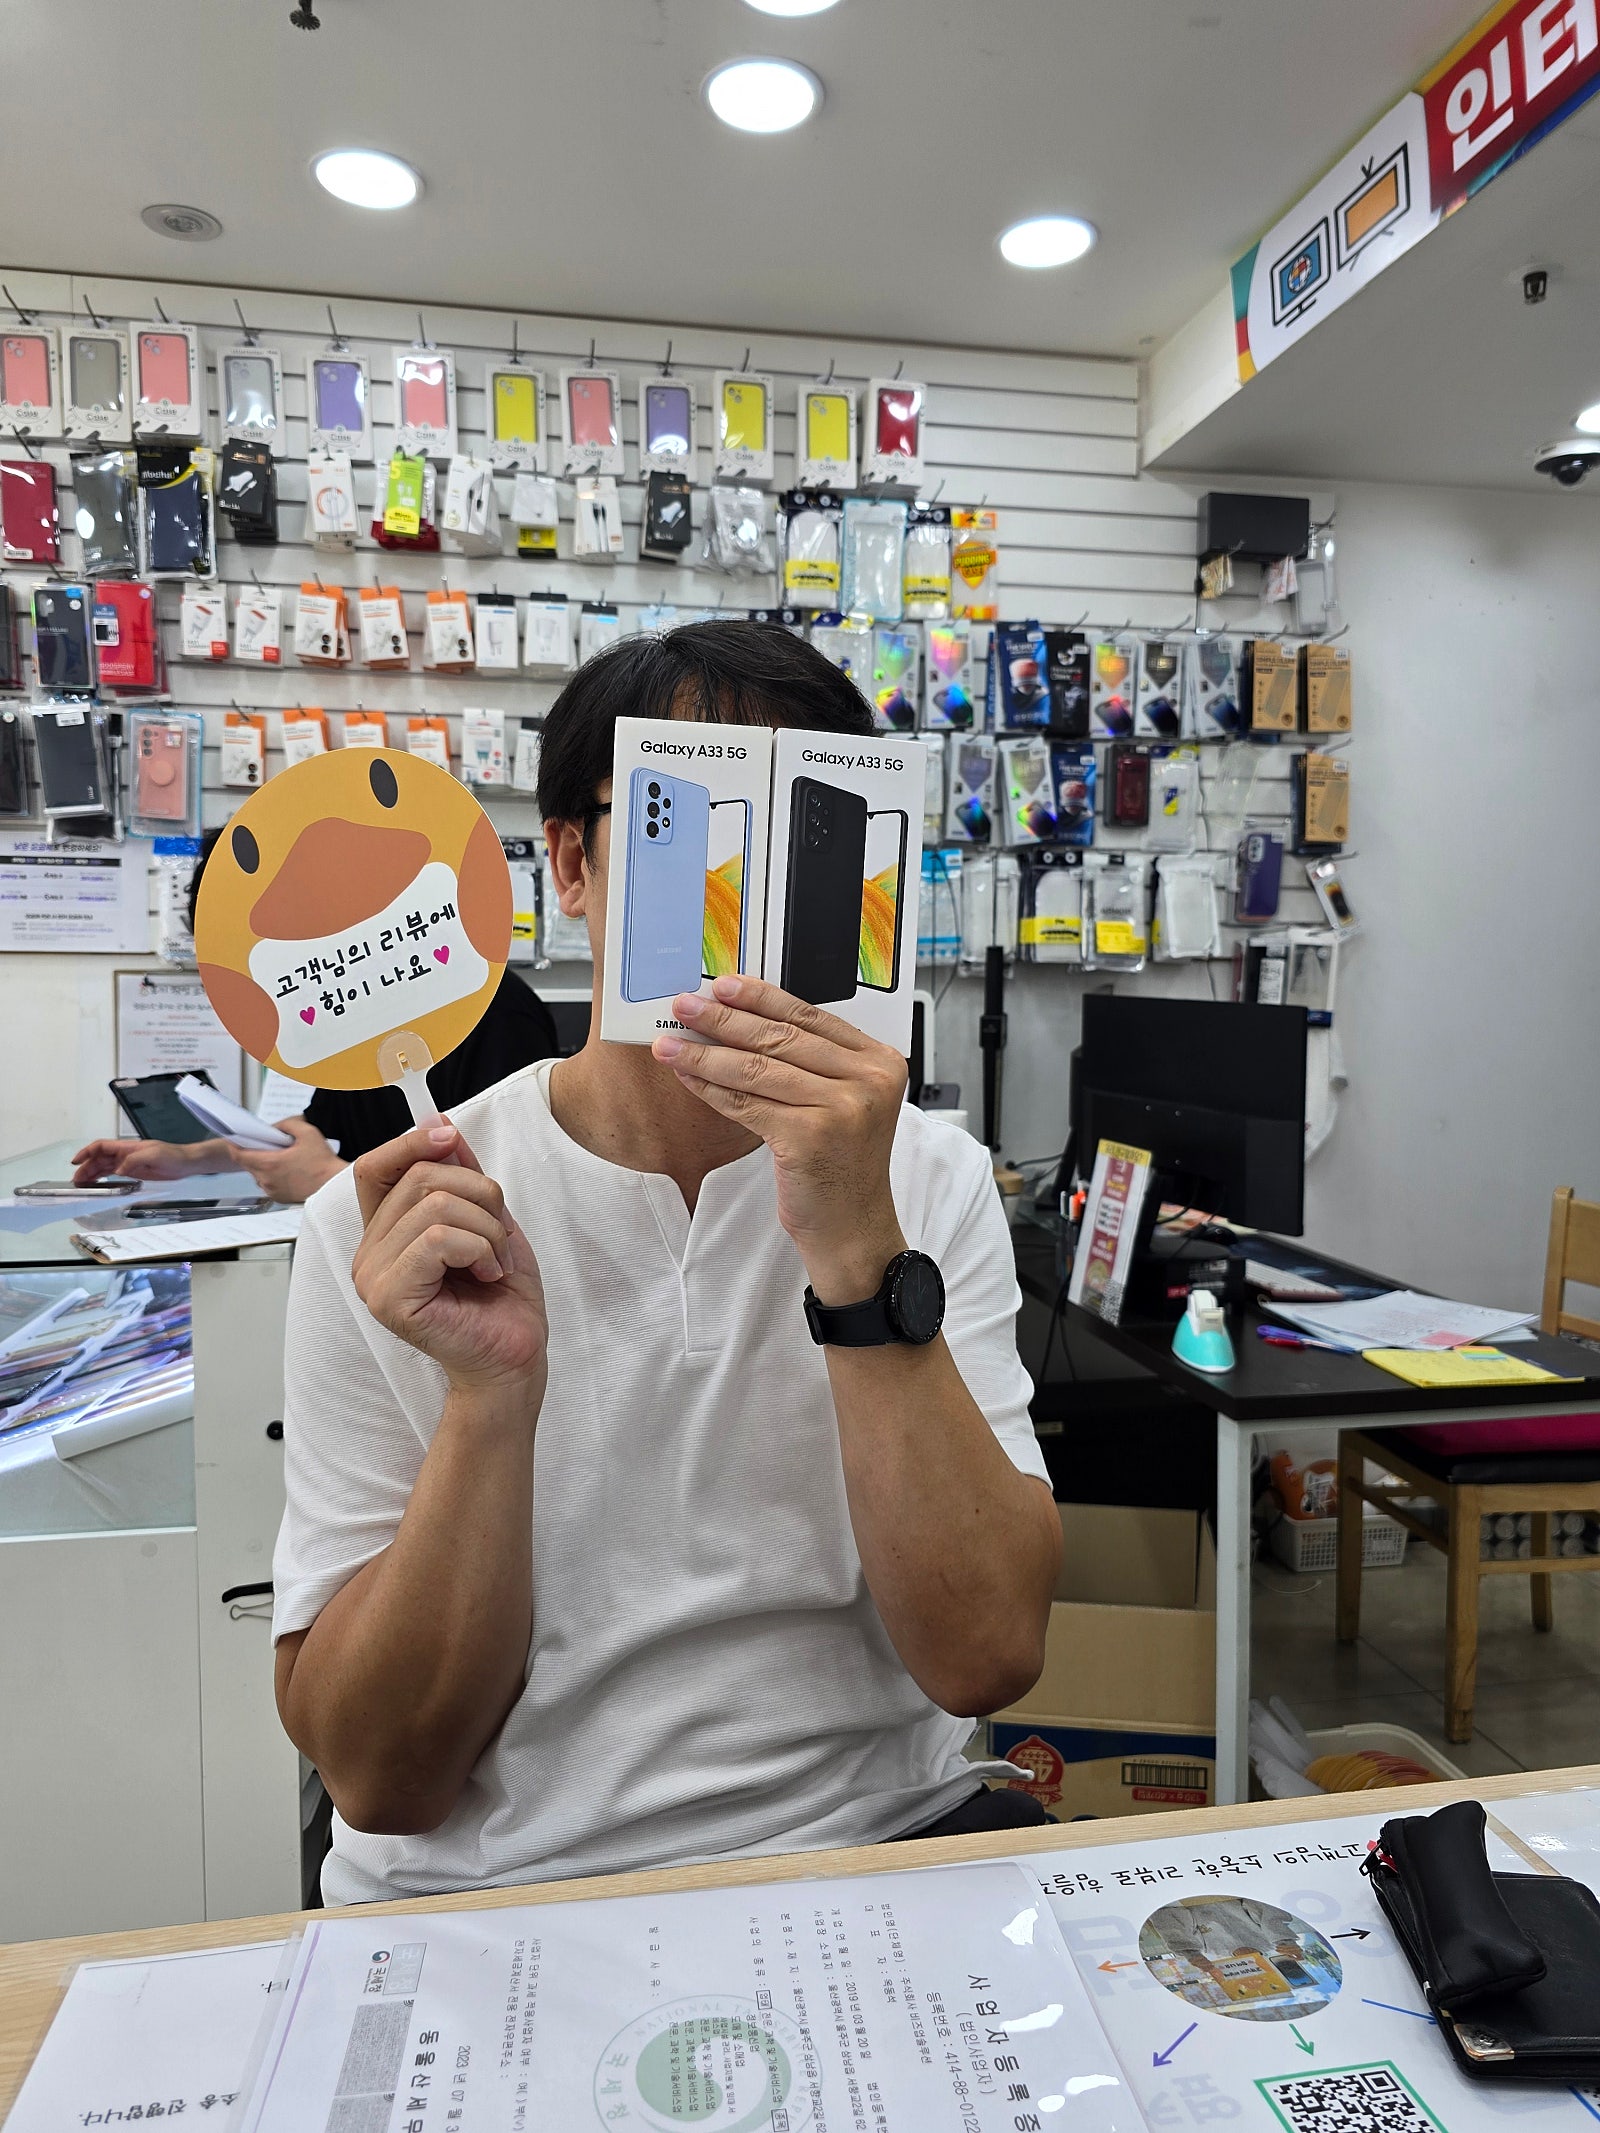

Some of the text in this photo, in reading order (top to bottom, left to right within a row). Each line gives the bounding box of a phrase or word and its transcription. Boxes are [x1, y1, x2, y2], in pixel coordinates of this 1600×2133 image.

[1446, 0, 1600, 172] 인터
[640, 741, 747, 760] Galaxy A33 5G
[802, 750, 903, 771] Galaxy A33 5G
[275, 903, 455, 999] 고객님의 리뷰에
[319, 954, 432, 1018] 힘이 나요
[1273, 1843, 1365, 1864] 고객님의
[1111, 1866, 1183, 1886] 리뷰로
[1192, 1854, 1262, 1880] 소중한
[814, 1910, 827, 1935] 사업장
[531, 1938, 542, 1961] 사업자
[820, 1943, 833, 1970] 소재지
[510, 1940, 524, 1992] 전자세금계산서
[529, 1964, 539, 1979] 단위
[368, 1967, 387, 1993] 국세청
[526, 1983, 537, 1998] 과세
[845, 1982, 858, 2001] 2019
[506, 1996, 518, 2011] 전용
[828, 1984, 845, 2022] 울산광역시
[899, 1976, 916, 2010] 주식회사
[793, 1988, 809, 2025] 울산광역시
[849, 2004, 862, 2012] 년
[926, 1992, 952, 2038] 등록번호
[522, 2002, 536, 2044] 적용사업자
[852, 2014, 865, 2025] 03
[500, 2015, 516, 2067] 전자우편주소
[730, 2016, 746, 2067] 도매 및 소매업
[746, 2014, 760, 2053] 정보통신업
[763, 2031, 775, 2046] 과학
[800, 2027, 814, 2051] 울주군
[836, 2024, 850, 2048] 울주군
[854, 2027, 867, 2036] 월
[857, 2037, 869, 2048] 20
[670, 2040, 679, 2054] 과학
[686, 2039, 695, 2053] 과학
[702, 2037, 711, 2051] 과학
[765, 2047, 777, 2055] 및
[860, 2050, 872, 2059] 일
[456, 2045, 471, 2068] 2023
[521, 2049, 531, 2066] 여부
[686, 2055, 695, 2063] 및
[702, 2054, 712, 2062] 및
[804, 2053, 819, 2079] 삼남읍
[840, 2050, 856, 2076] 삼남읍
[453, 2073, 467, 2084] 년
[671, 2066, 682, 2113] 기술서비스업
[687, 2065, 699, 2112] 기술서비스업
[703, 2064, 716, 2110] 기술서비스업
[769, 2057, 783, 2103] 기술서비스업
[451, 2090, 465, 2102] 07
[78, 2091, 240, 2126] 소송 진행합니다.
[448, 2108, 462, 2119] 월
[856, 2119, 867, 2130] 62
